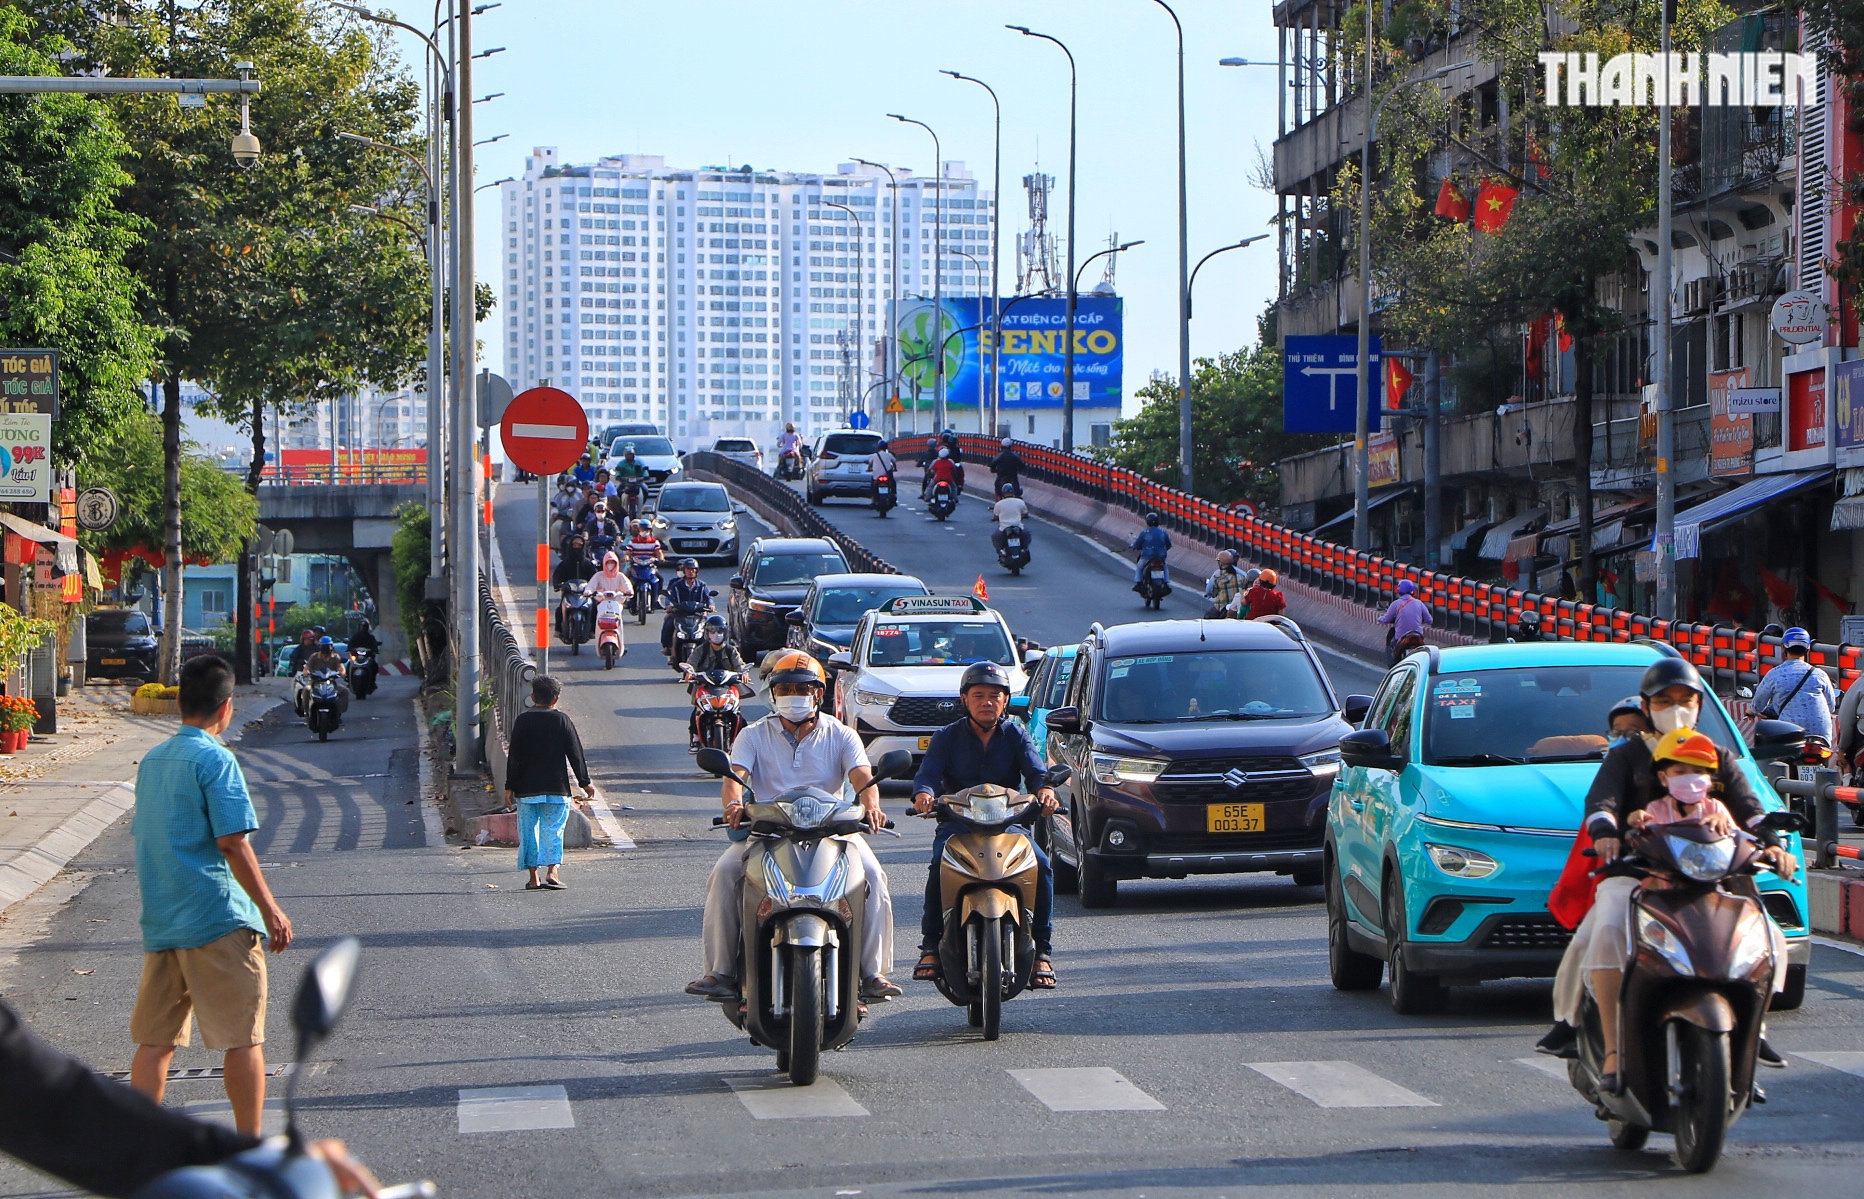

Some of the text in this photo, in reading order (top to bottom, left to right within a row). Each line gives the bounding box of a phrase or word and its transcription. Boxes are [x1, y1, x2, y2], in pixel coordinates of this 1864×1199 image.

[986, 315, 1019, 326] ẠT
[1020, 313, 1049, 326] ĐIỆN
[1078, 311, 1104, 324] CẤP
[1779, 325, 1822, 333] PRUDENTIAL
[977, 329, 1117, 354] SENKO
[2, 354, 53, 373] TÓC GIẢ
[1287, 352, 1301, 363] THỦ
[1303, 352, 1325, 363] THIÊM
[1338, 353, 1355, 363] BÌNH
[1043, 363, 1061, 374] cho
[1085, 362, 1109, 375] sống
[2, 375, 54, 395] TÓC GIẢ
[13, 398, 38, 413] TÓC
[1732, 397, 1778, 406] mizu store
[11, 445, 45, 464] 99K
[911, 599, 969, 607] VINASUN TAXI
[1224, 805, 1248, 818] 65E
[1214, 818, 1259, 831] 003.37
